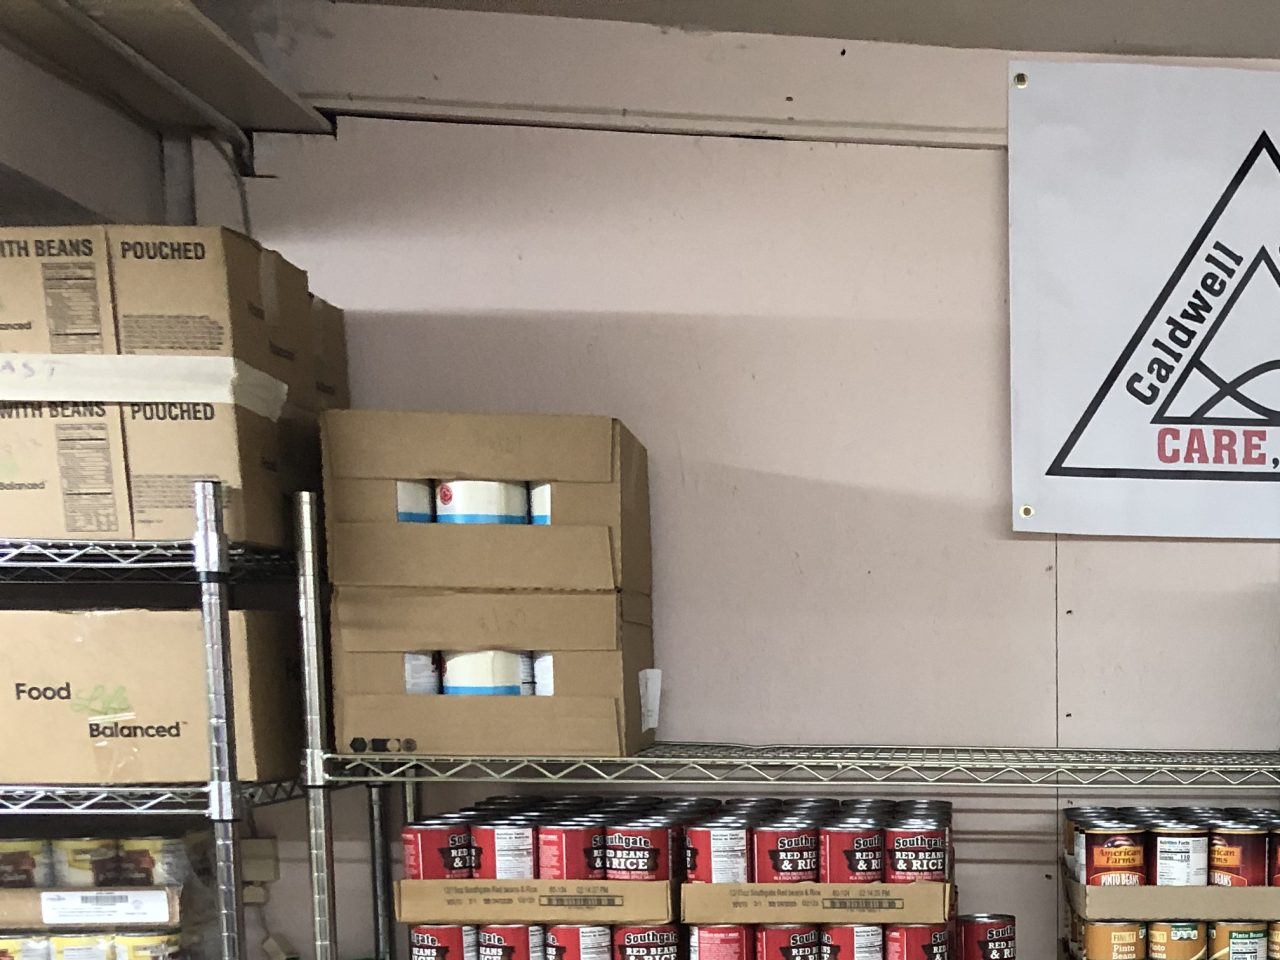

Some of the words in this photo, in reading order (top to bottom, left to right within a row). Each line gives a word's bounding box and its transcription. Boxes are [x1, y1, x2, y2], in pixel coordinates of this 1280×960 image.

[0, 239, 30, 257] ITH
[34, 239, 94, 257] BEANS
[120, 241, 206, 260] POUCHED
[1126, 241, 1243, 406] Caldwell
[131, 402, 216, 421] POUCHED
[1157, 427, 1280, 470] CARE,
[15, 682, 71, 700] Food
[89, 721, 182, 739] Balanced
[617, 850, 650, 859] BEANS
[779, 851, 801, 860] RED
[855, 851, 875, 860] RED
[895, 851, 915, 860] RED
[1099, 847, 1140, 857] American
[612, 859, 648, 870] RICE
[798, 860, 817, 870] RIC
[911, 859, 943, 870] RICE
[1101, 873, 1121, 886] PINTO
[1121, 873, 1140, 886] BEANS
[1214, 872, 1232, 886] BEANS
[988, 941, 1007, 949] RED
[1113, 944, 1135, 952] Pinto
[626, 947, 648, 956] RED
[791, 947, 811, 956] RED
[1112, 952, 1136, 960] Beans
